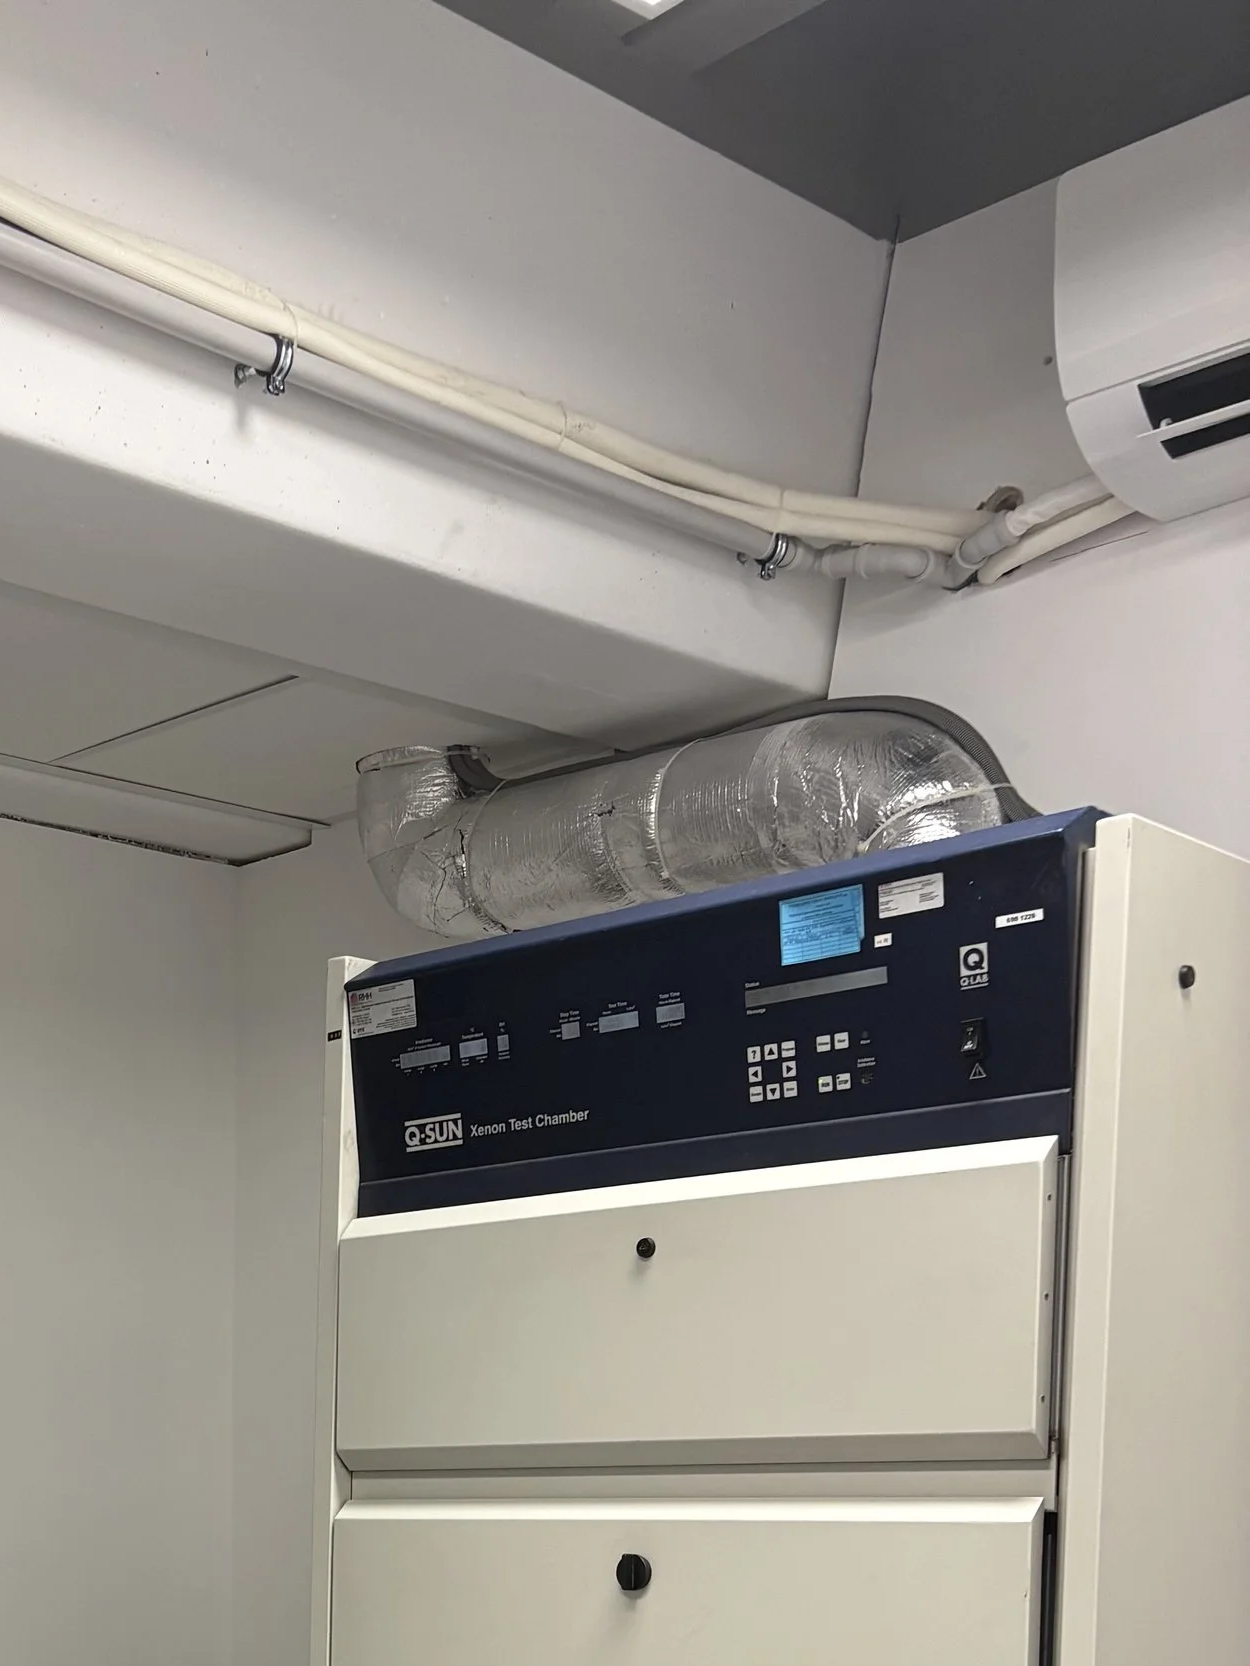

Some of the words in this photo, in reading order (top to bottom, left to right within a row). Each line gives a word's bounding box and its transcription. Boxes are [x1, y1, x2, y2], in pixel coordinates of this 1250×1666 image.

[404, 1119, 463, 1147] Q-SUN
[470, 1122, 506, 1138] Xenon
[508, 1117, 532, 1132] Test
[535, 1110, 590, 1128] Chamber
